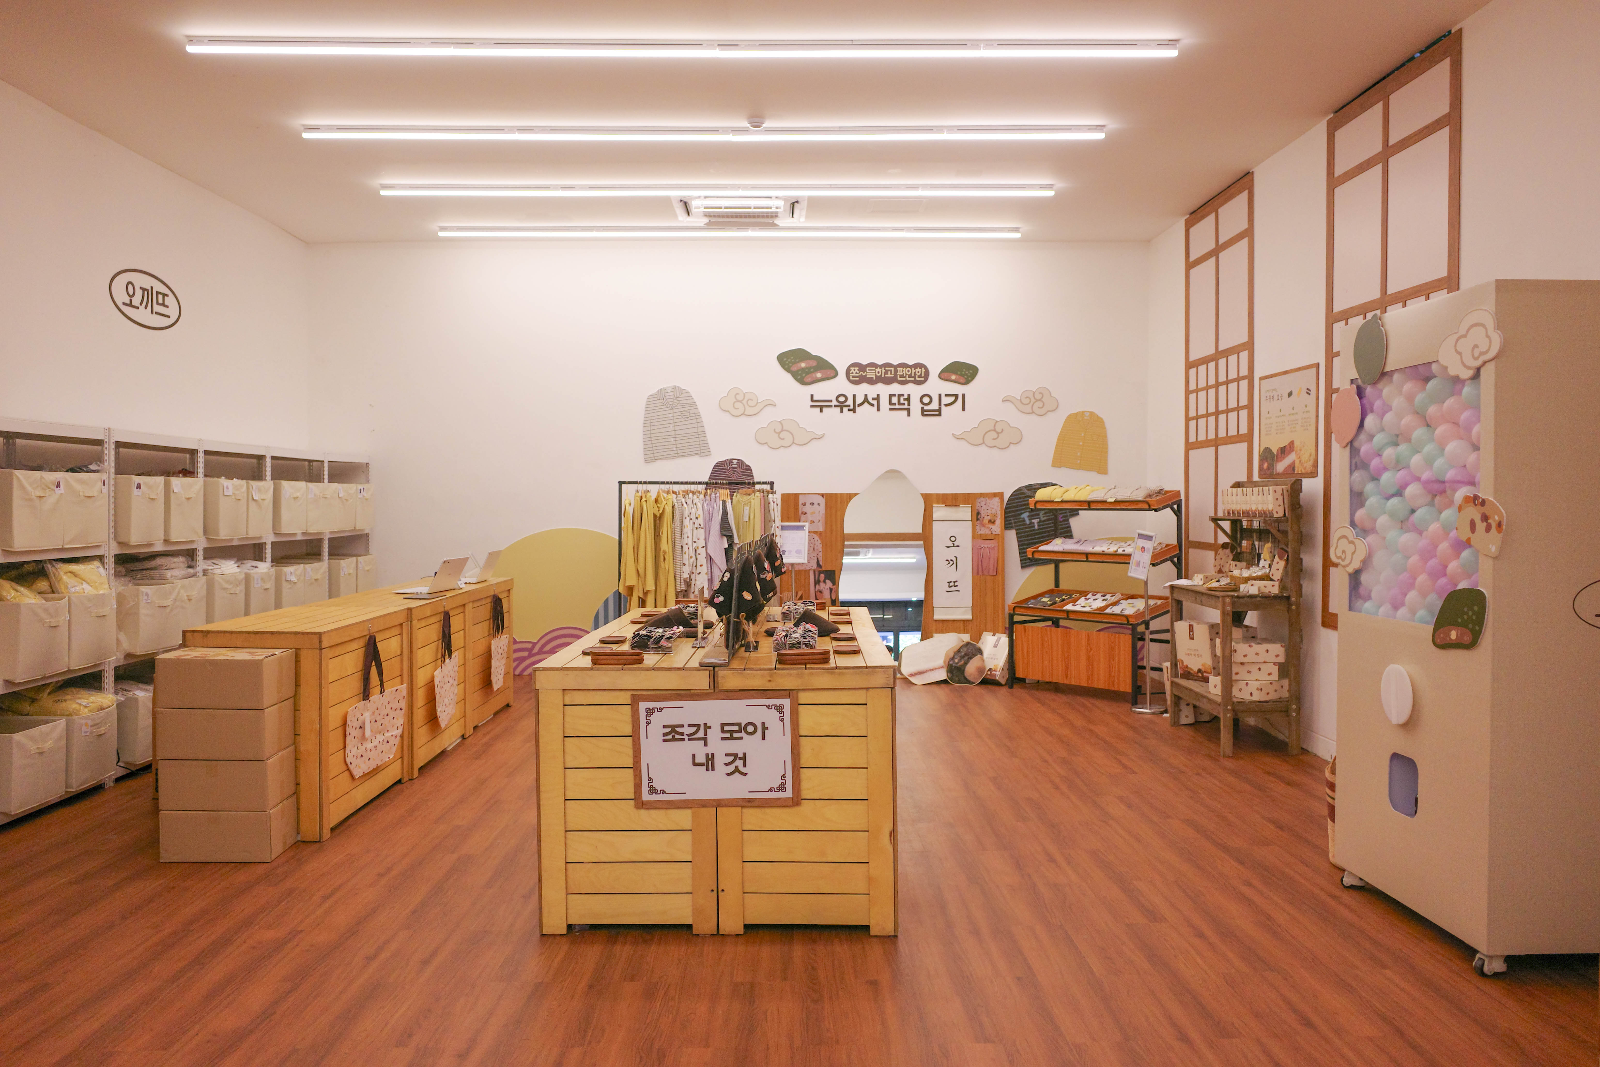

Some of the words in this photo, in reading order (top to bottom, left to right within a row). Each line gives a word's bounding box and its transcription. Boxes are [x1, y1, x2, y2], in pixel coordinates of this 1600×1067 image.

[122, 280, 171, 319] 오끼뜨
[896, 366, 926, 381] 편안한
[809, 393, 881, 414] 누워서
[888, 393, 911, 417] 떡
[919, 393, 966, 417] 입기
[662, 722, 712, 747] 조각
[719, 721, 769, 742] 모아
[691, 752, 716, 772] 내
[723, 751, 749, 777] 것
